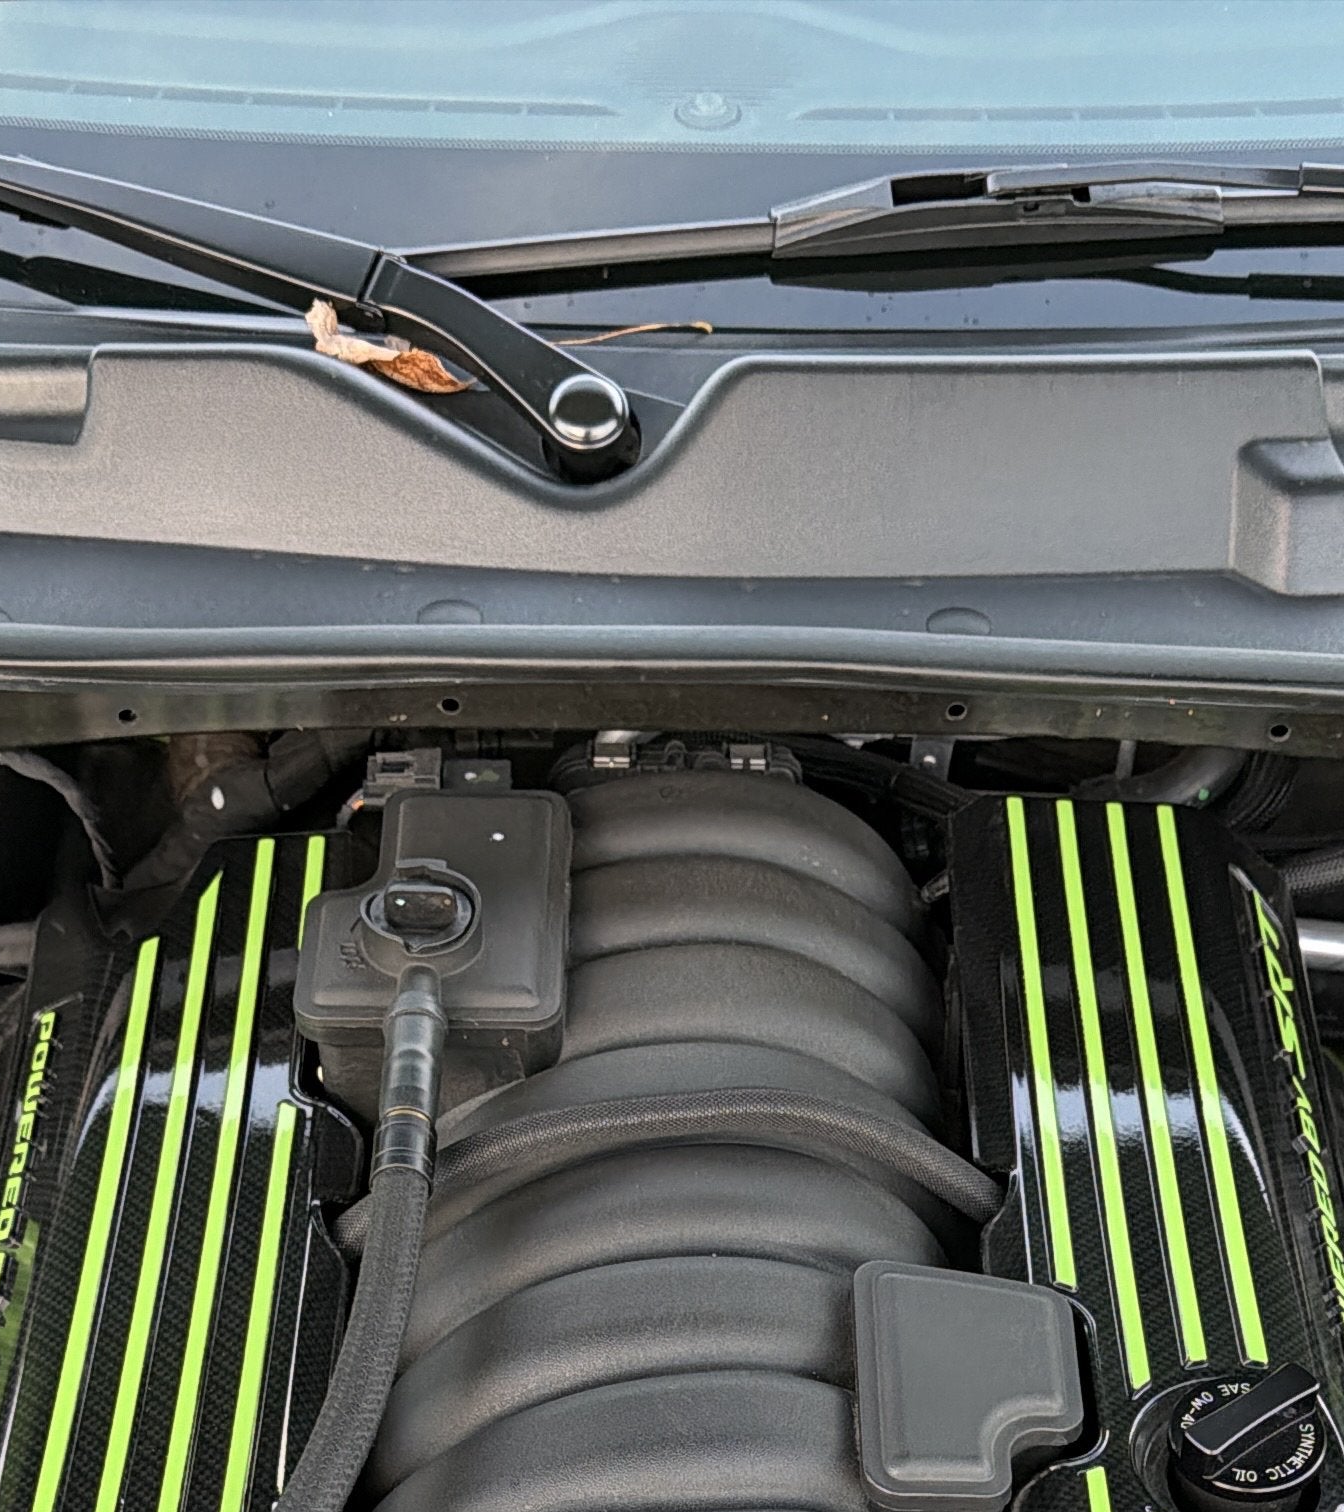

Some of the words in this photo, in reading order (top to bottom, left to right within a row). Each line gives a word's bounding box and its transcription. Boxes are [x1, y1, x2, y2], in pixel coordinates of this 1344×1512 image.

[1254, 889, 1306, 1081] SRT
[1293, 1076, 1320, 1154] BY
[1217, 1382, 1251, 1398] SAE
[1231, 1467, 1258, 1483] OIL
[1265, 1423, 1315, 1480] SYNTHETIC
